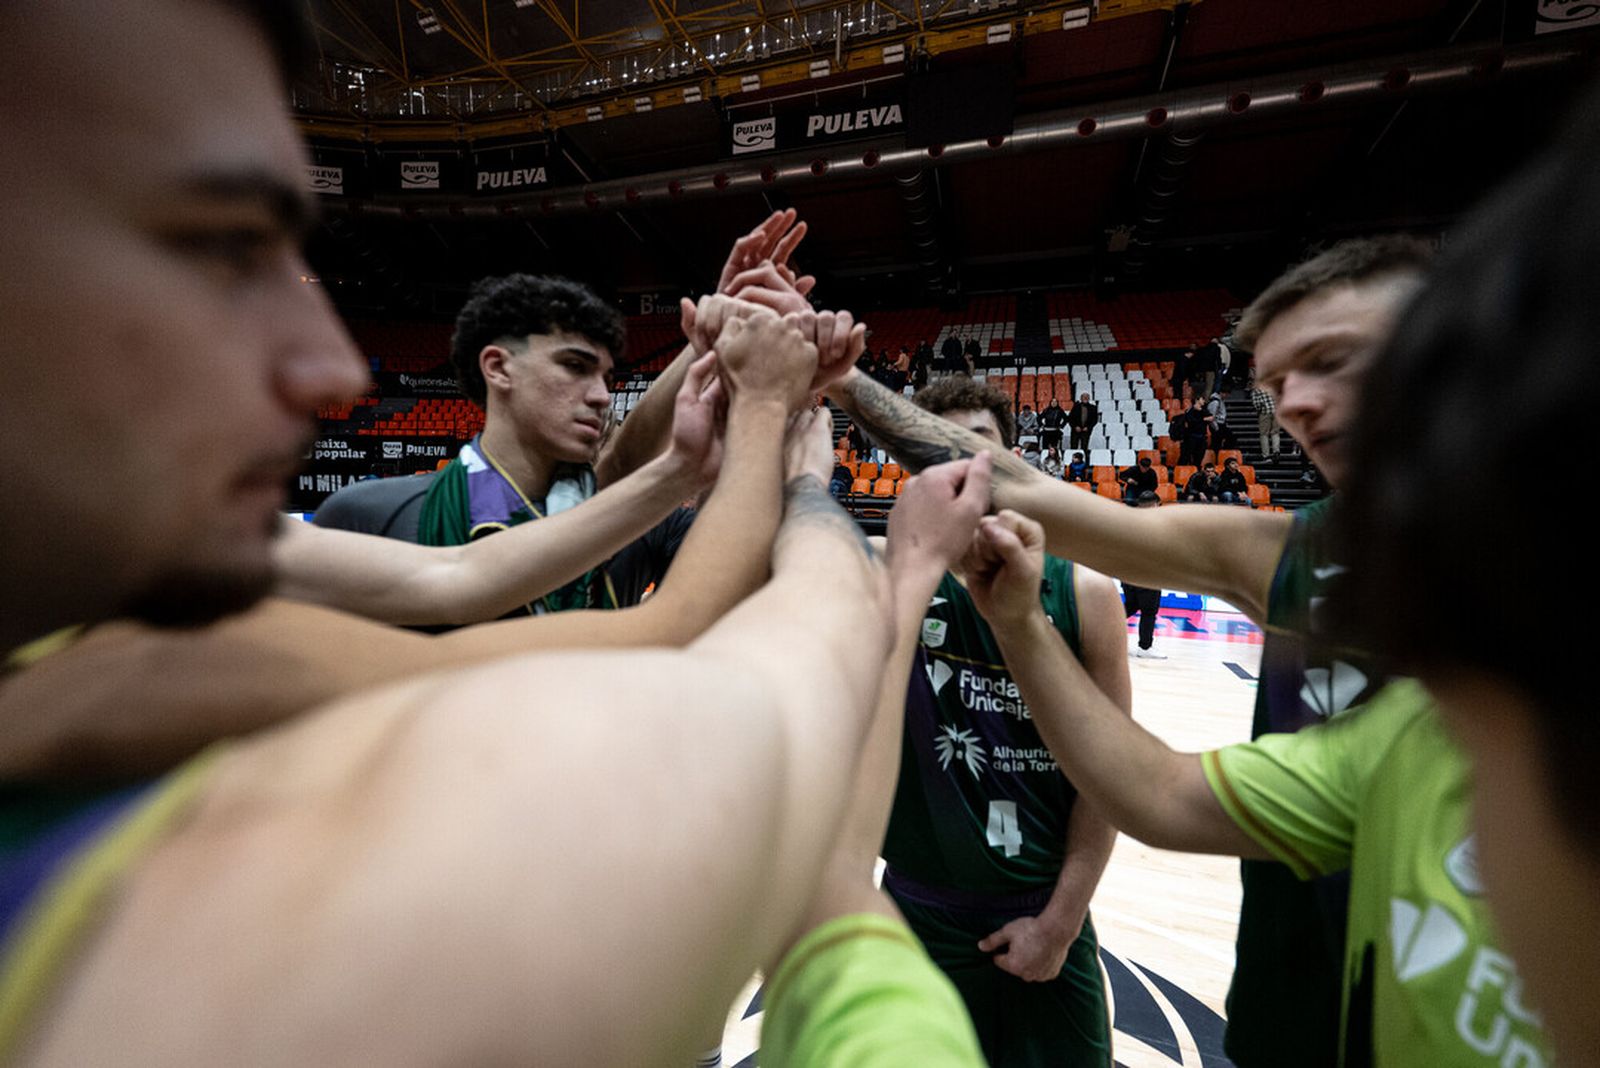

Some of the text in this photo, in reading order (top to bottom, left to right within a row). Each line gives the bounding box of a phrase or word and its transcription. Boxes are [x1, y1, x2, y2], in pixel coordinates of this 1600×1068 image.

[806, 103, 903, 138] PULEVA
[735, 122, 773, 136] PULEVA
[304, 167, 340, 179] ULEVA
[403, 164, 438, 174] PULEVA
[477, 166, 548, 191] PULEVA
[314, 438, 348, 449] caixa
[405, 443, 448, 457] PULEVA
[314, 448, 367, 460] popular
[959, 668, 1021, 698] Funda
[959, 688, 1033, 721] Unicaja
[993, 759, 1011, 773] de
[1012, 759, 1026, 772] la
[985, 800, 1023, 857] 4
